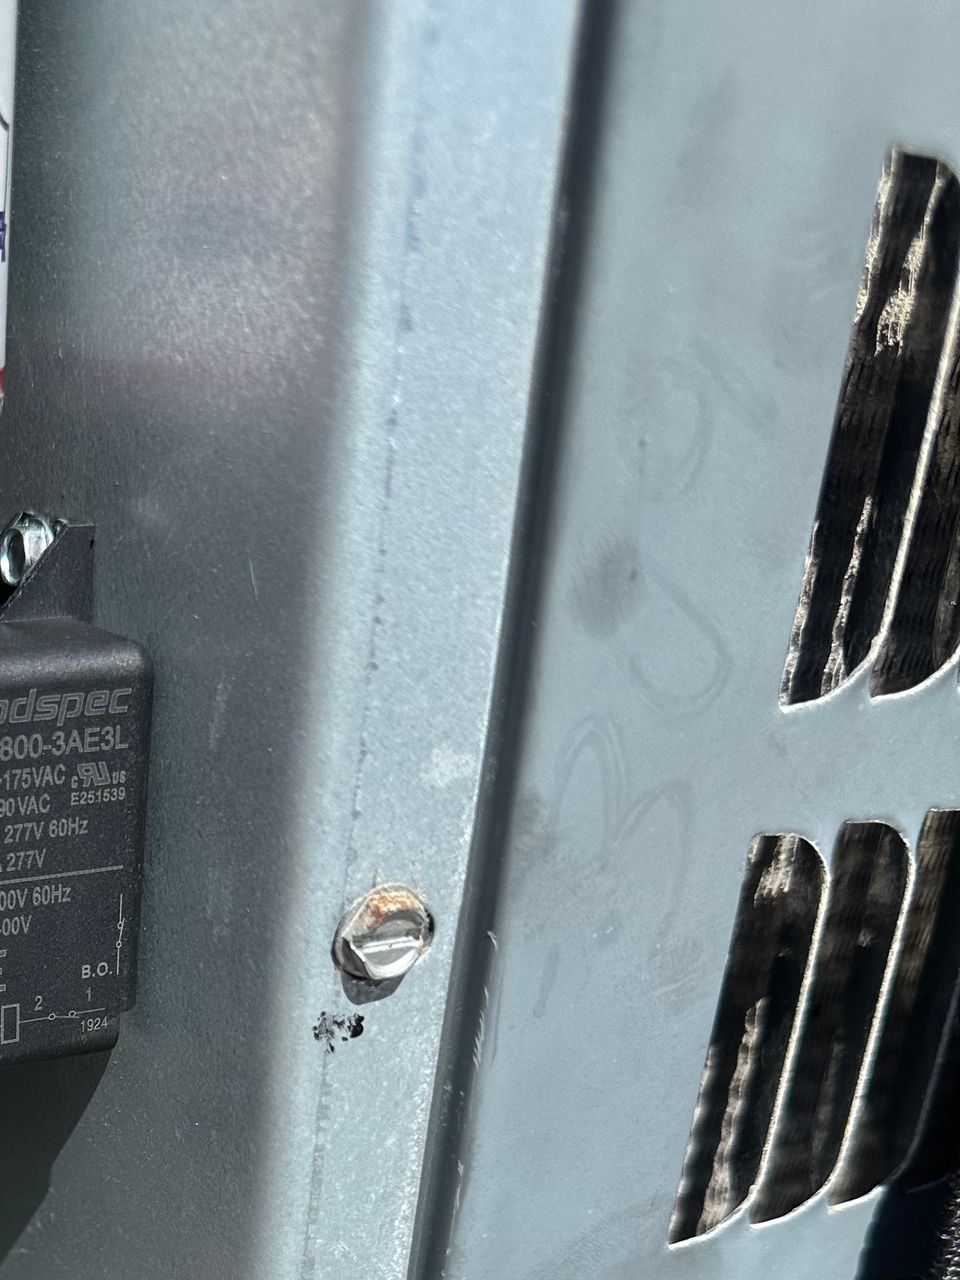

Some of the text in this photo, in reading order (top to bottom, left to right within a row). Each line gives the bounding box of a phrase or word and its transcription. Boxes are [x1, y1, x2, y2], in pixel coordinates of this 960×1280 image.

[70, 786, 127, 806] E251539
[4, 821, 45, 844] 277V
[48, 816, 89, 838] 60Hz
[6, 848, 47, 872] 277V
[32, 883, 72, 907] 60Hz
[81, 961, 113, 979] B.O.
[34, 995, 43, 1011] 2
[80, 1016, 109, 1033] 1924
